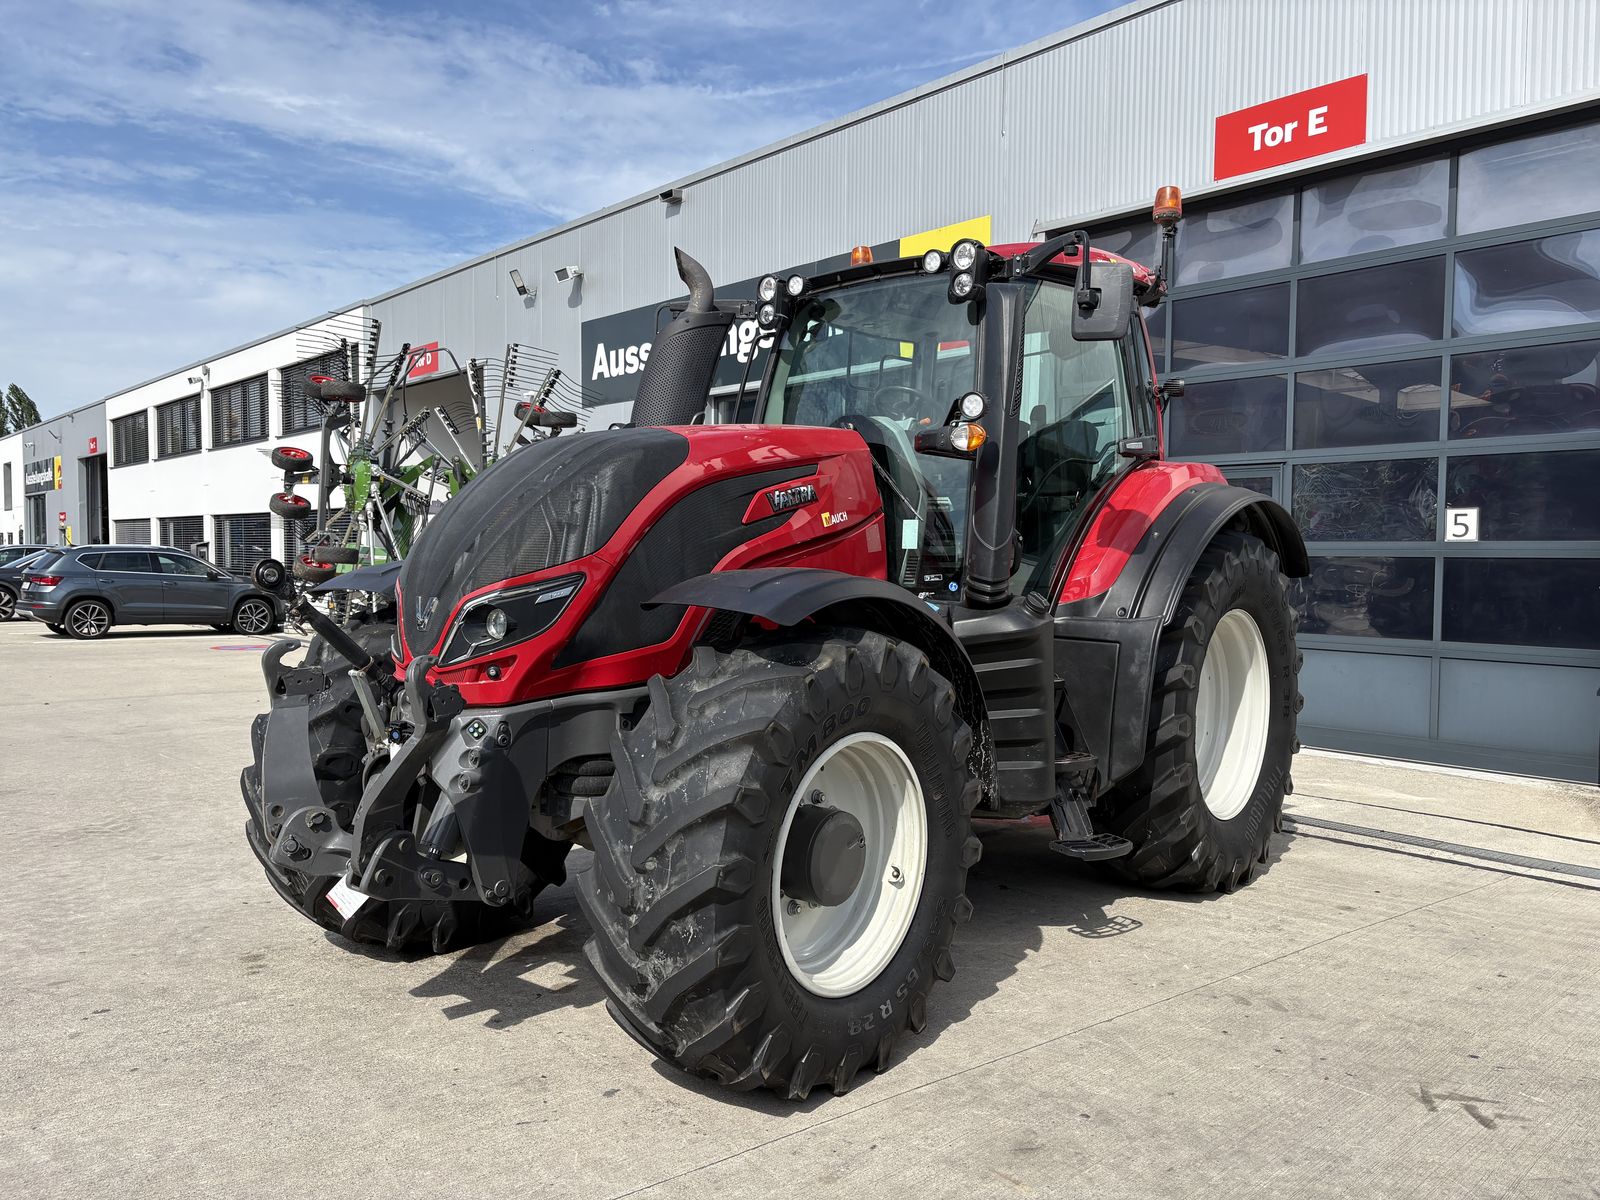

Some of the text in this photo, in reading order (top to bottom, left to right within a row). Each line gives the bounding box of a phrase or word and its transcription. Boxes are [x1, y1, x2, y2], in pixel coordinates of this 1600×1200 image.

[1248, 105, 1328, 151] Tor E
[426, 353, 432, 365] D
[766, 485, 818, 512] VALTRA
[821, 511, 848, 528] MAUCH
[1452, 513, 1469, 537] 5
